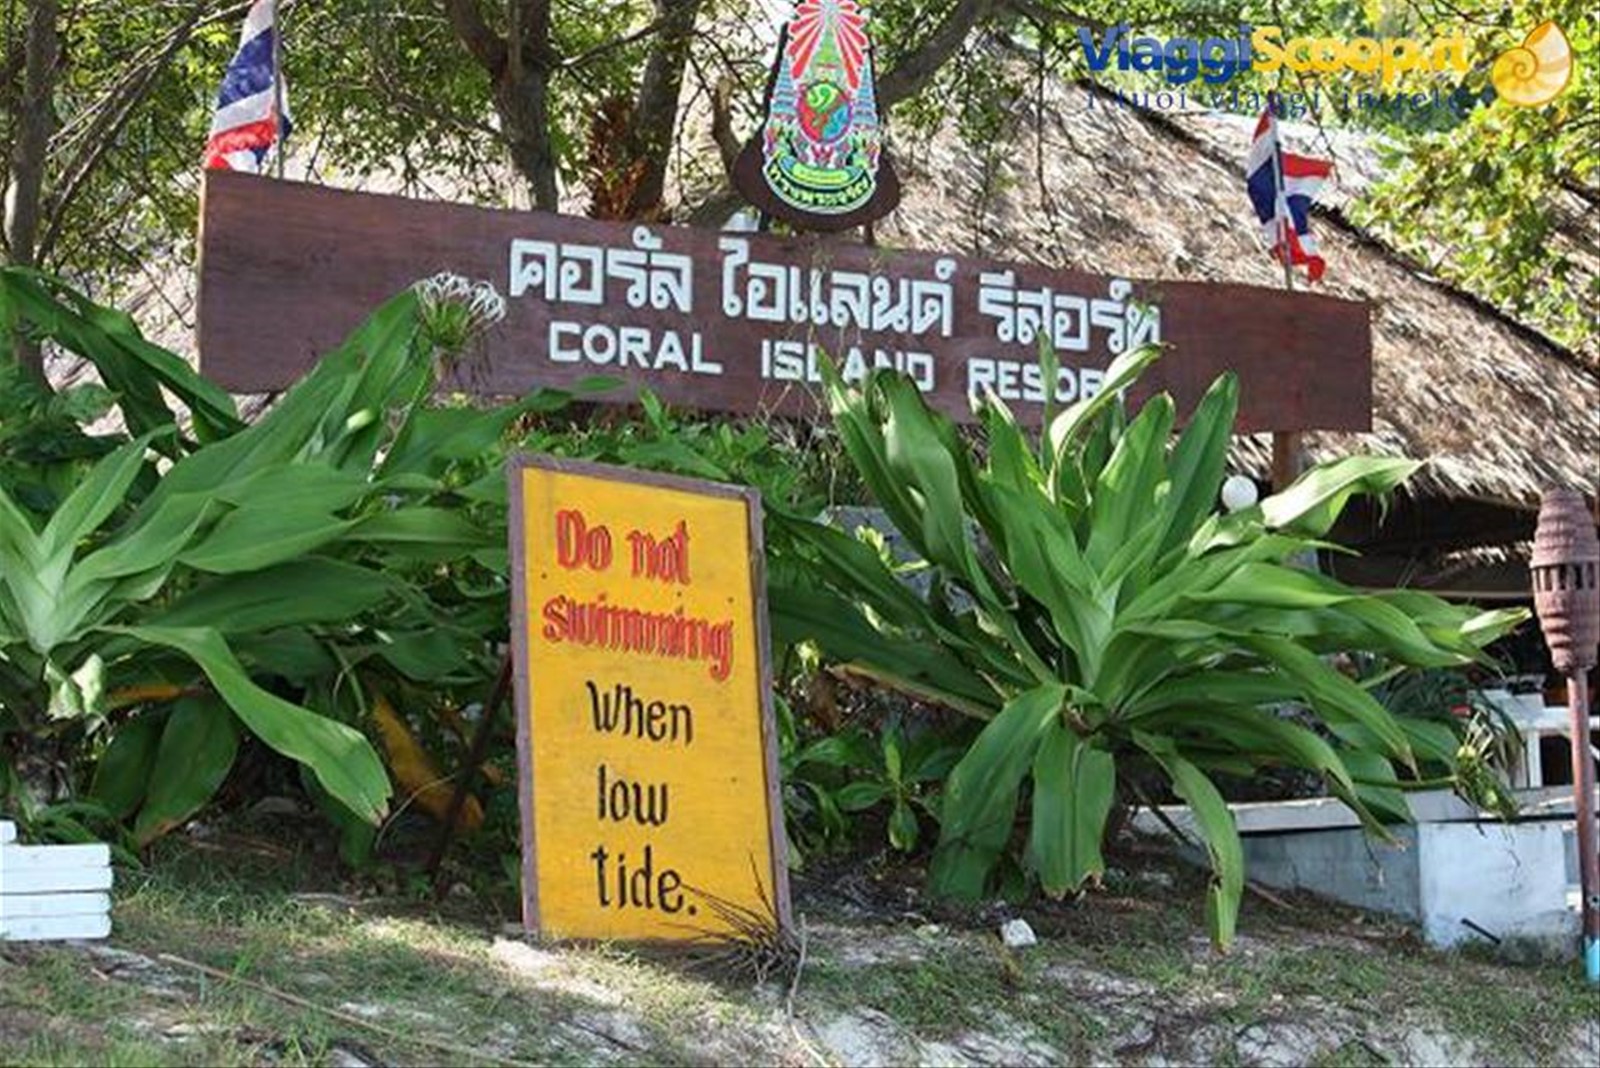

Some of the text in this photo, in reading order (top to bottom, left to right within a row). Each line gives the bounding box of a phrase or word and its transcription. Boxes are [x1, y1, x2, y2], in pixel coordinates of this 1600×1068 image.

[509, 225, 692, 312] คอรัล
[718, 236, 956, 337] ไอแลนด์
[549, 320, 723, 374] CORAL
[968, 358, 1128, 406] RESOR
[555, 508, 690, 586] Do not
[586, 680, 694, 746] When
[598, 763, 668, 826] low
[591, 844, 697, 916] tide.
